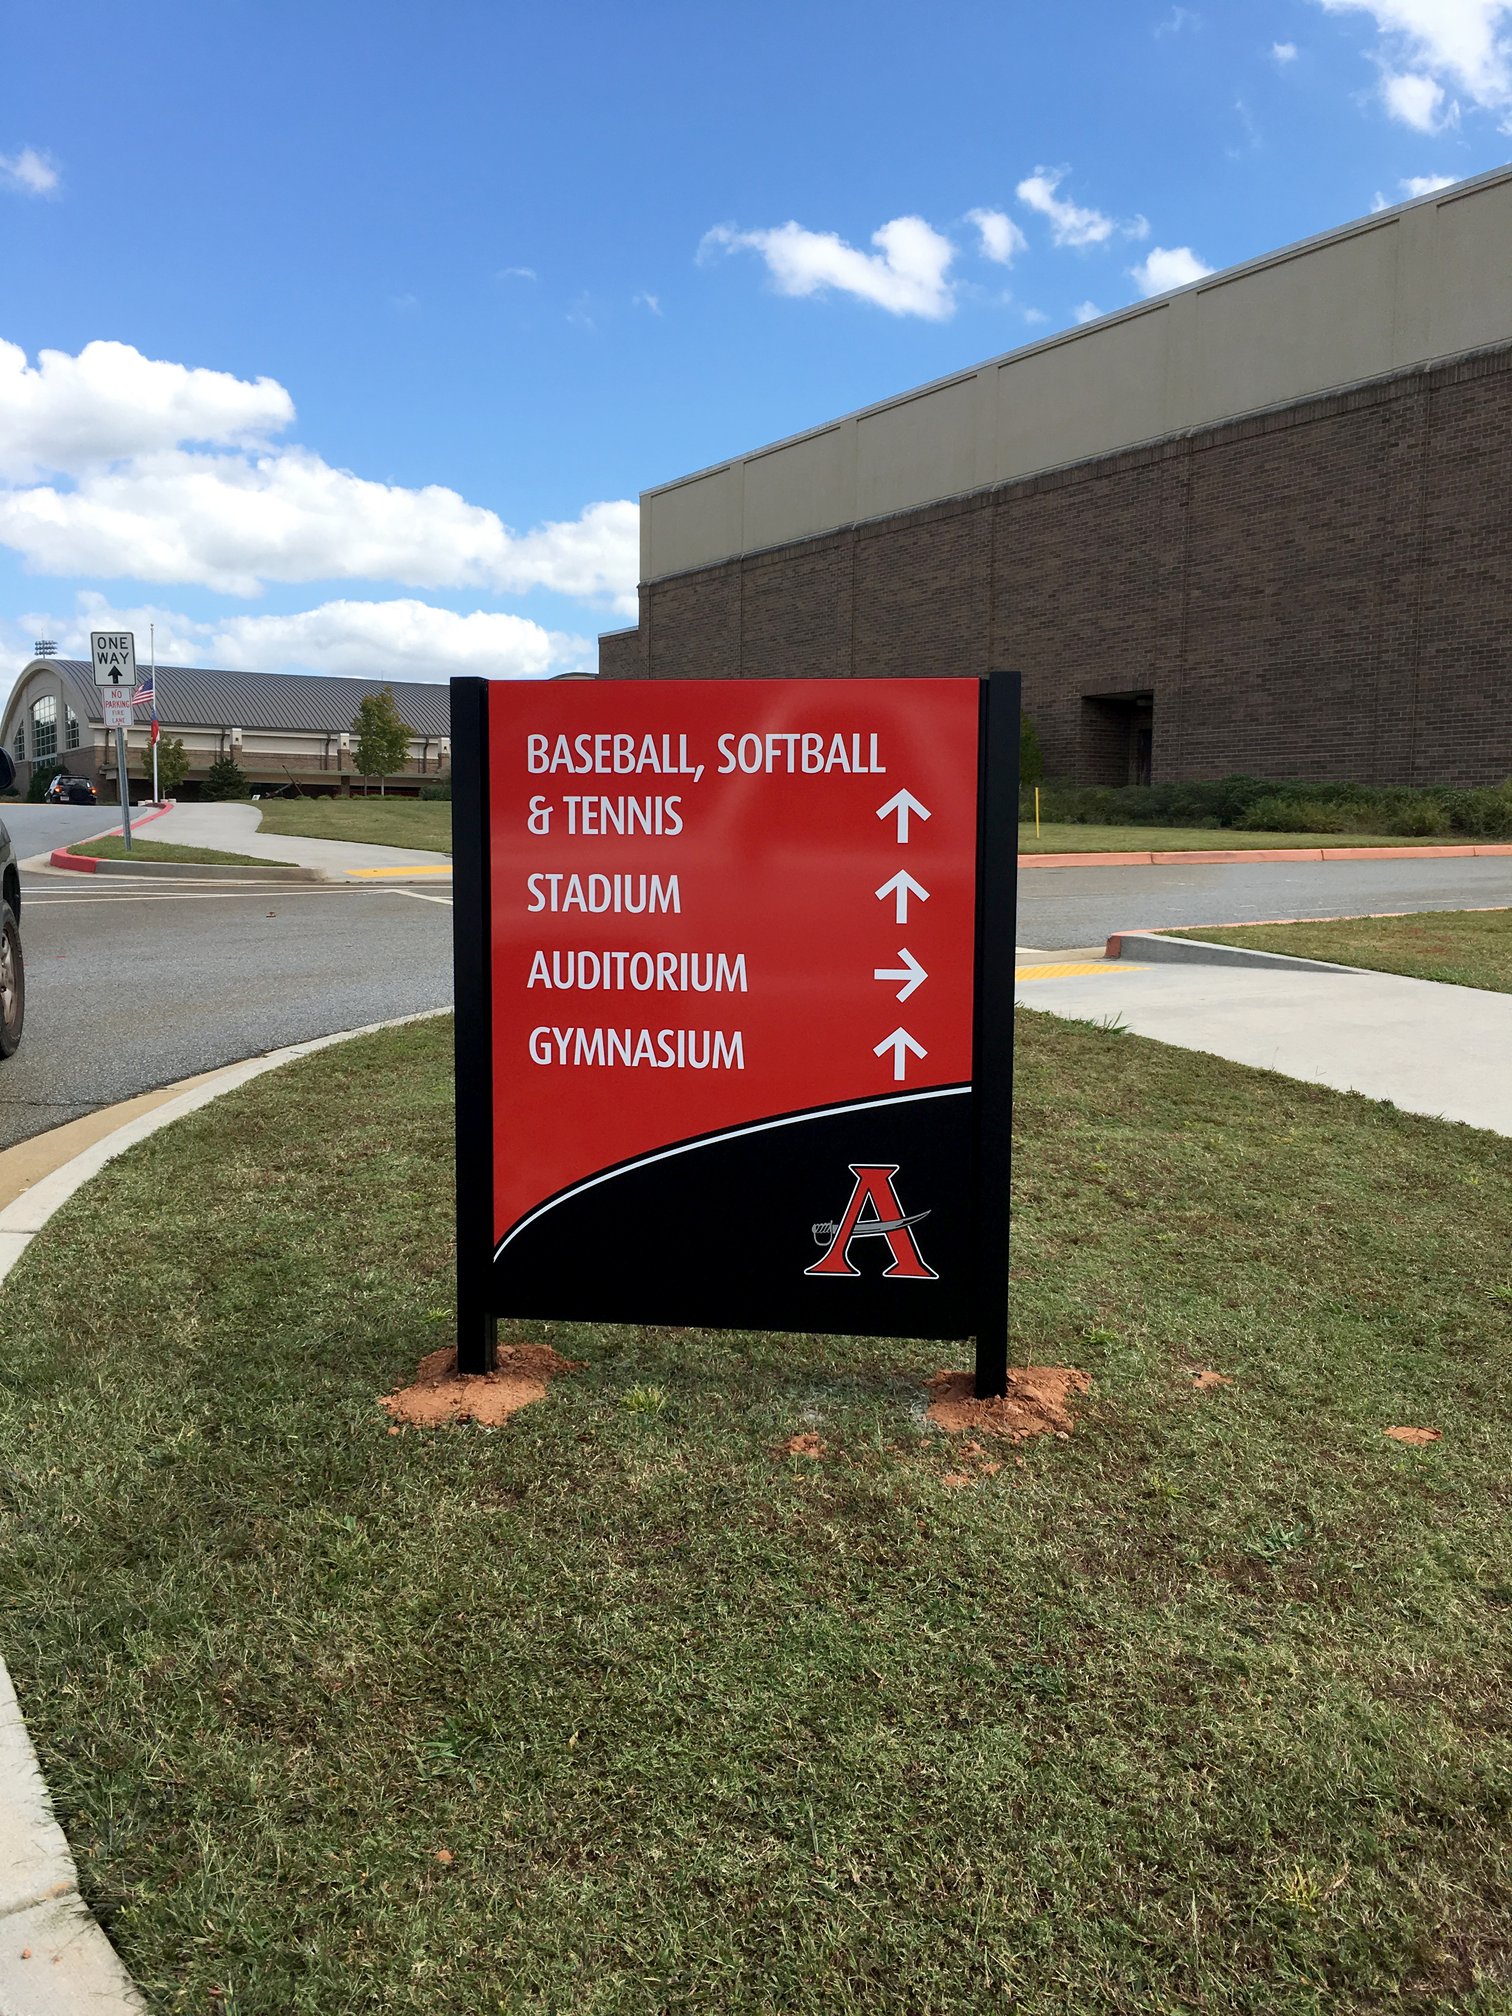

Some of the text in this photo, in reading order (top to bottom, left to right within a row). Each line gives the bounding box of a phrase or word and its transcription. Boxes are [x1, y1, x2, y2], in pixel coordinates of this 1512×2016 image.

[97, 637, 129, 650] ONE
[97, 652, 129, 665] WAY
[105, 700, 130, 709] PARKING
[111, 690, 122, 699] NO
[527, 732, 886, 783] BASEBALL, SOFTBALL
[527, 795, 683, 836] & TENNIS
[527, 873, 682, 914] STADIUM
[526, 950, 748, 993] AUDITORIUM
[528, 1026, 745, 1070] GYMNASIUM
[804, 1164, 940, 1280] A
